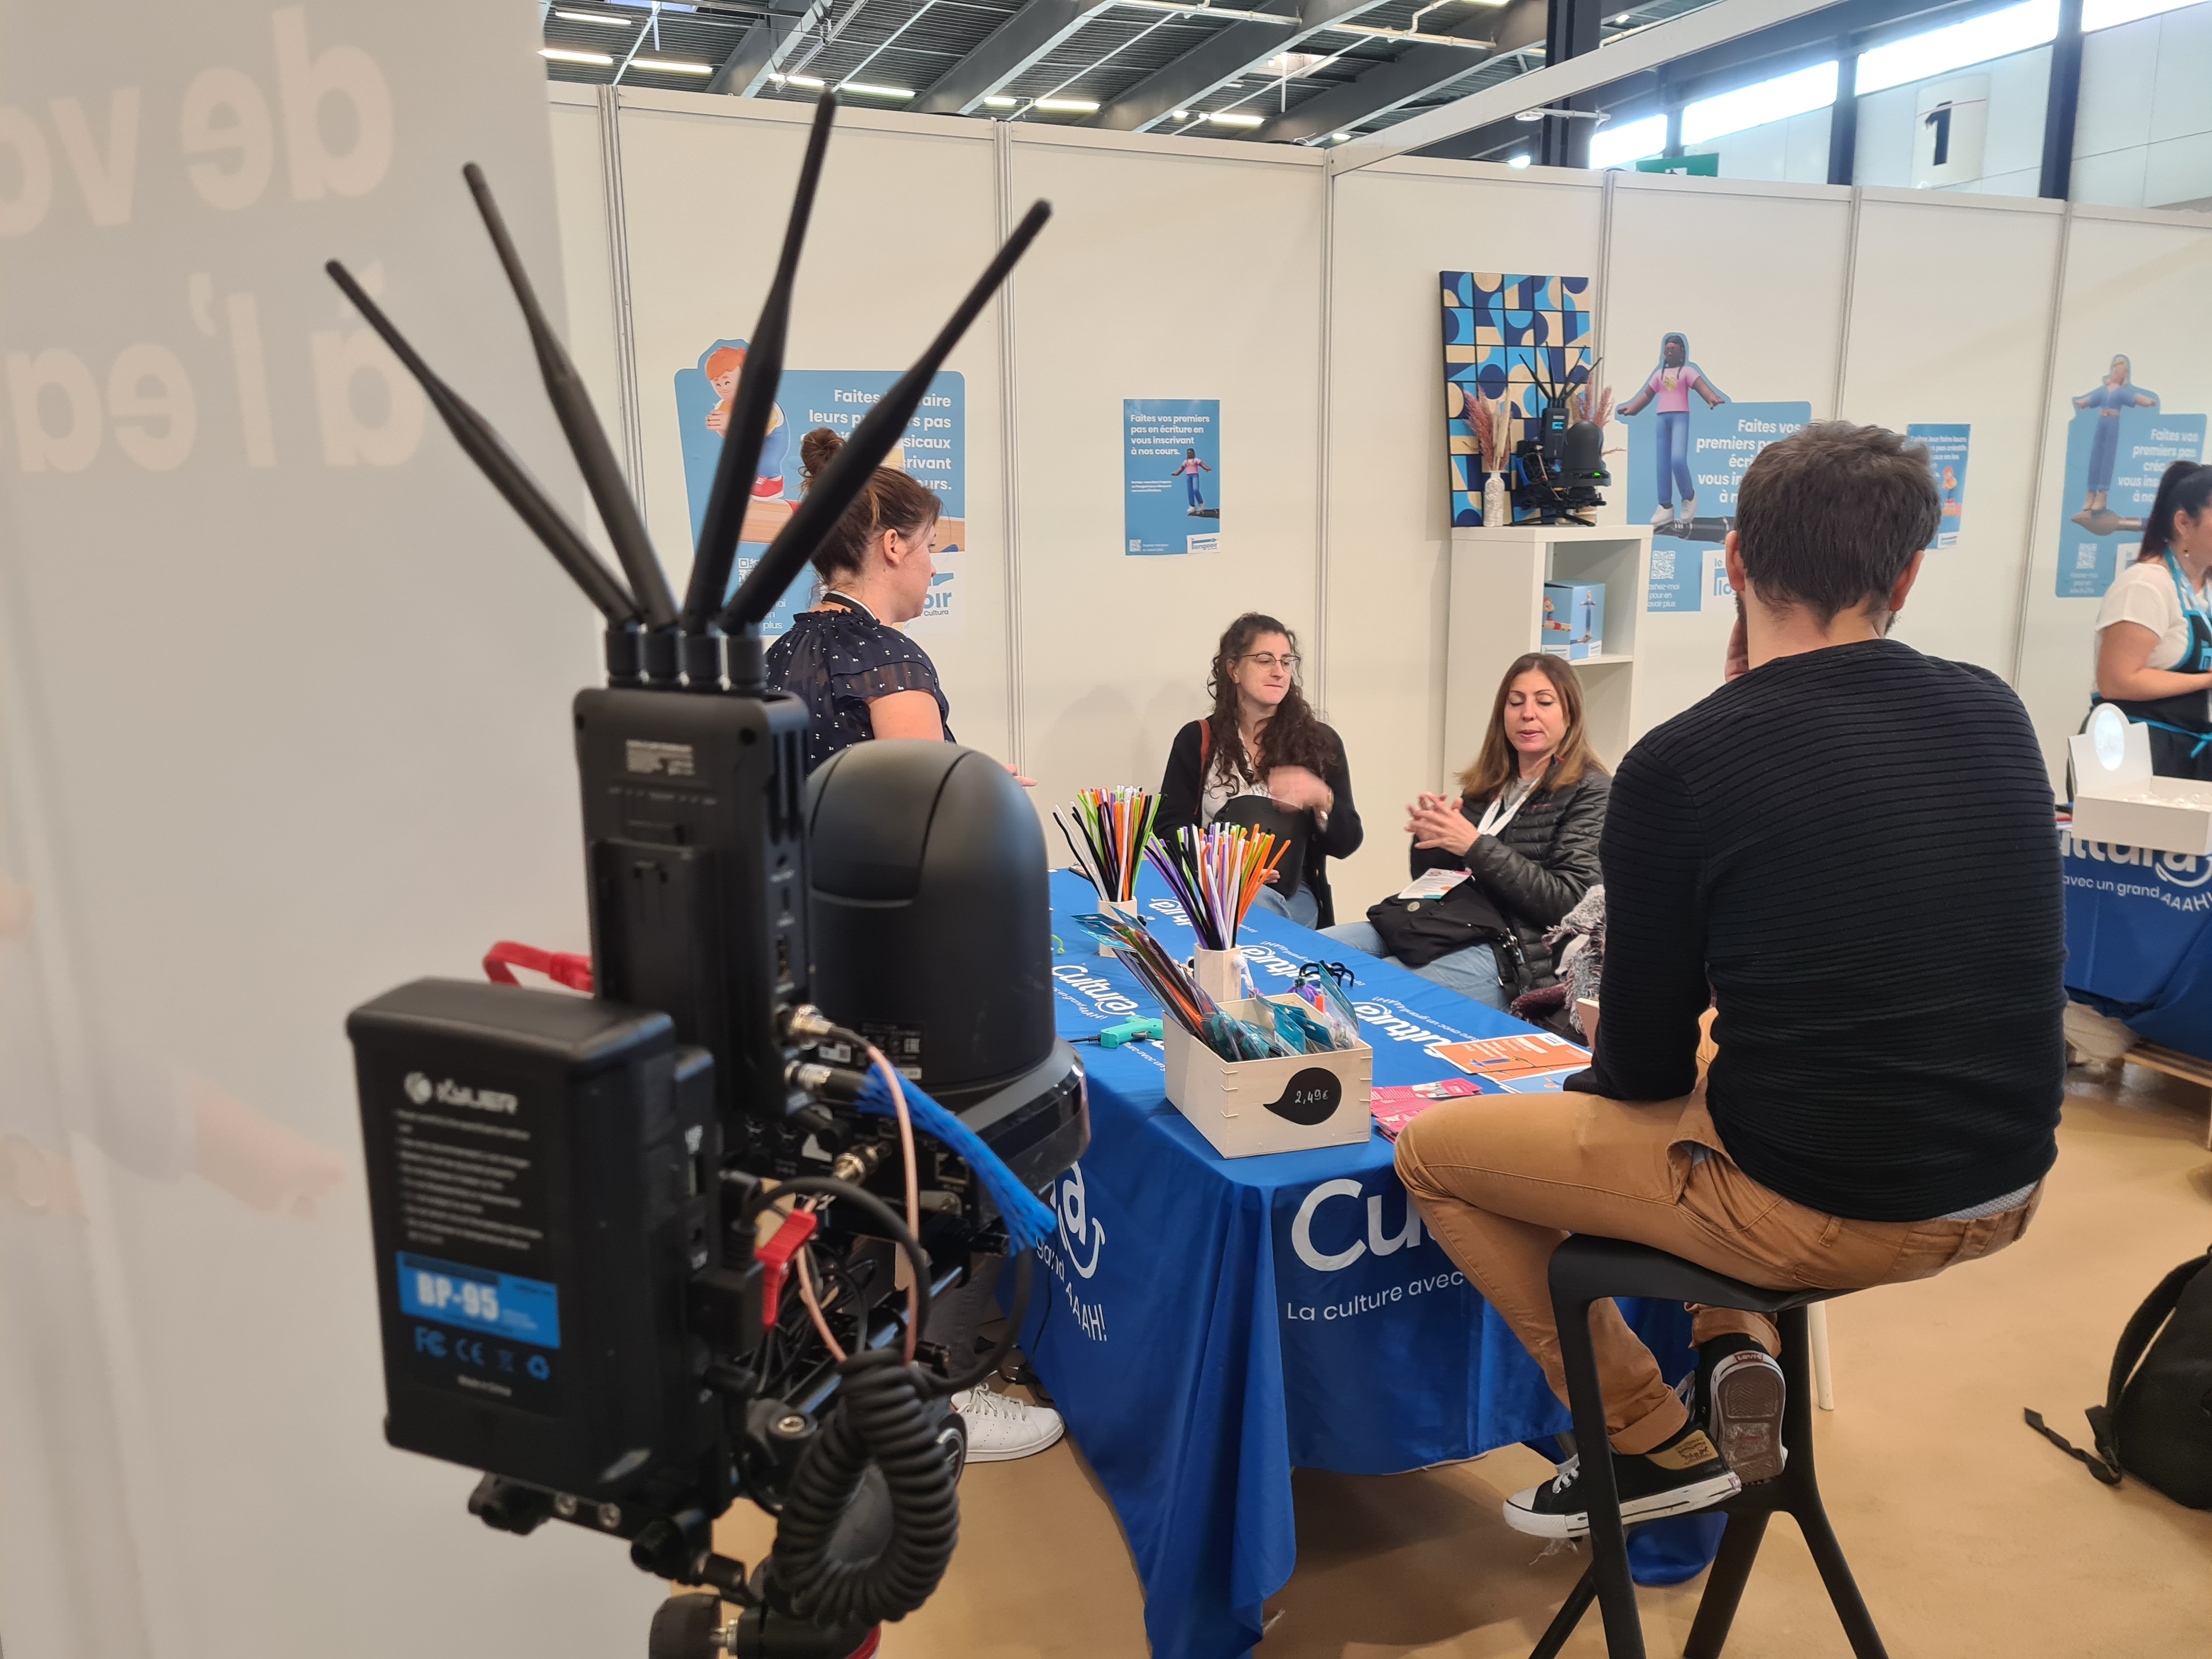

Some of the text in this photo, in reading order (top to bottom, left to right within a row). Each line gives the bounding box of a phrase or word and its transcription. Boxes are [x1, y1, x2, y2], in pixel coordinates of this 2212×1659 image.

[1924, 100, 1953, 166] 1
[834, 389, 952, 408] Faites aire
[809, 409, 848, 424] leurs
[923, 417, 952, 431] pas
[1130, 414, 1156, 422] Faites
[1173, 414, 1210, 424] premiers
[1737, 419, 1802, 433] Faites vos
[1130, 427, 1147, 435] pas
[1160, 425, 1193, 433] écriture
[1153, 436, 1195, 444] inscrivant
[1696, 436, 1756, 453] premiers
[1131, 447, 1137, 455] à
[1697, 474, 1729, 486] vous
[1719, 489, 1728, 503] à
[763, 620, 783, 631] plus
[2096, 879, 2114, 891] un
[2117, 882, 2160, 898] grand
[1052, 964, 1139, 1015] Cultura
[1294, 1088, 1329, 1105] 2,49€
[1287, 1271, 1464, 1321] La culture avec
[1065, 1281, 1107, 1342] AAAH!
